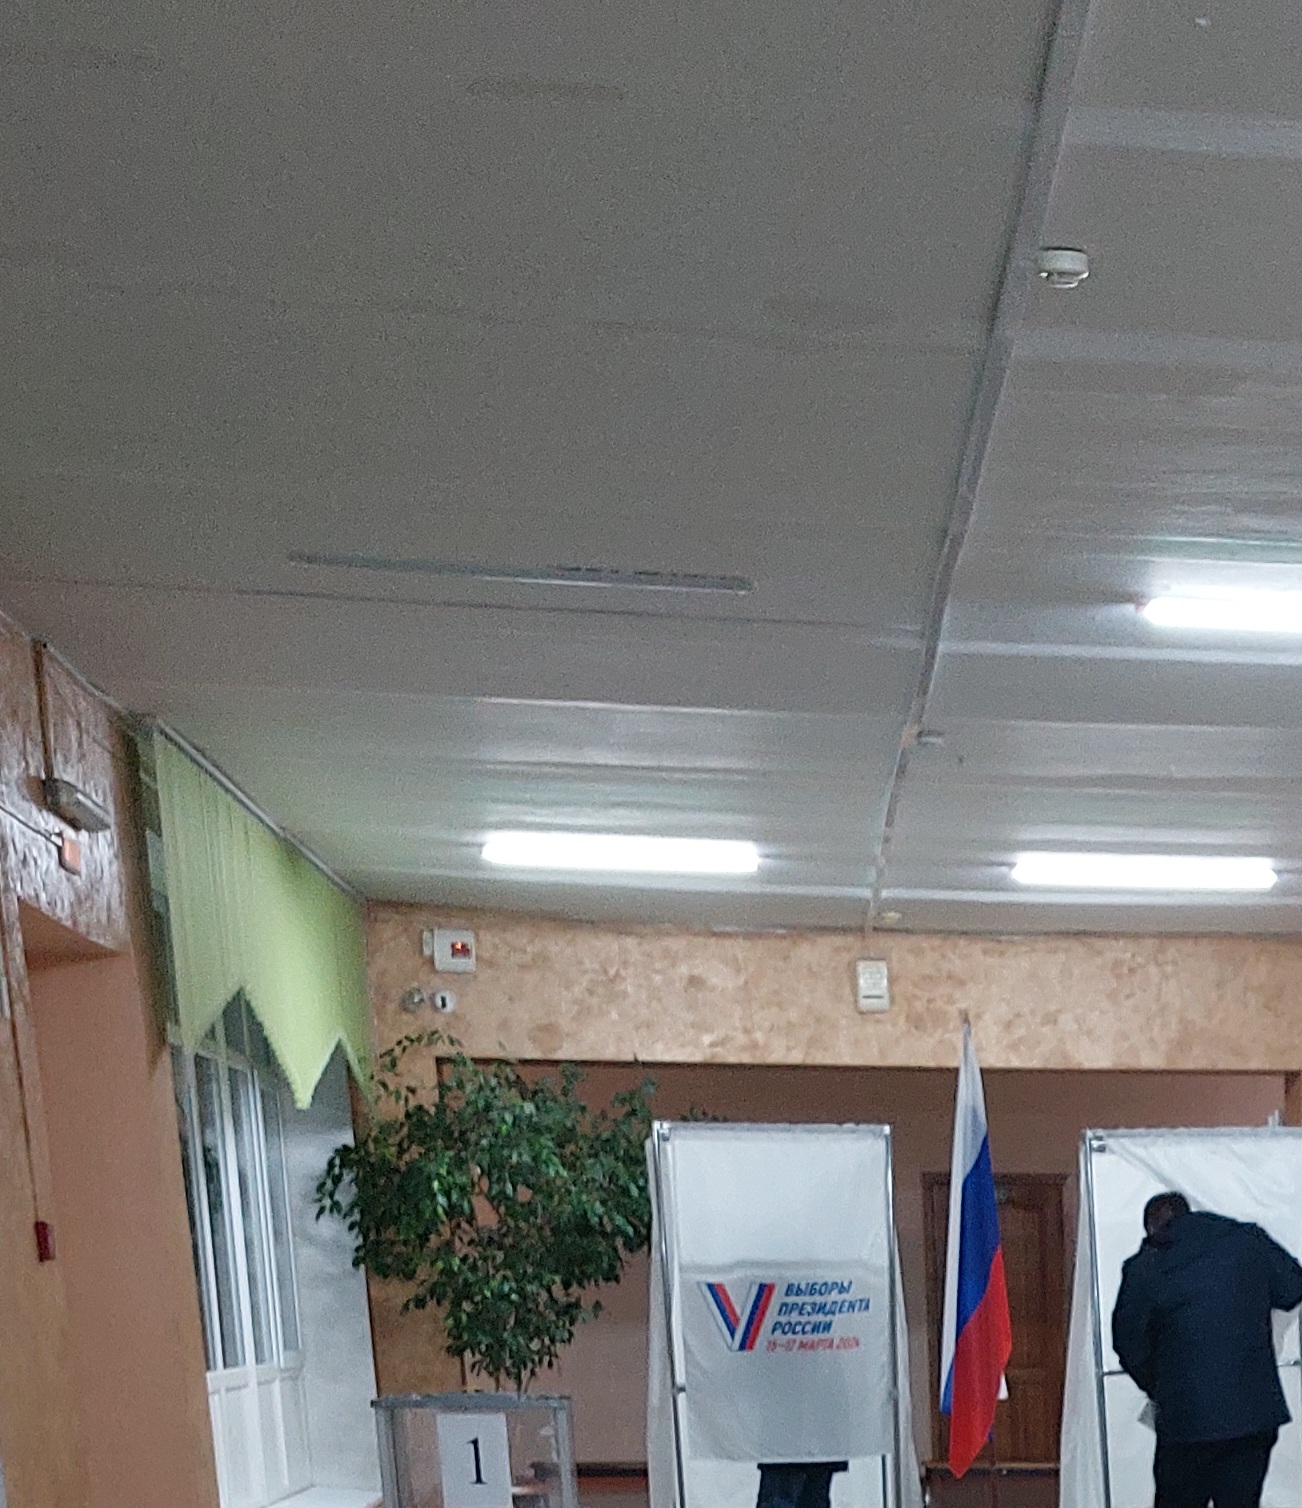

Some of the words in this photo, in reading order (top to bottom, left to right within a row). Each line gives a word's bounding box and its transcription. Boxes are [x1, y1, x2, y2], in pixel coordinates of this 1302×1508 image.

[784, 1280, 853, 1298] ВЫБОРЫ
[777, 1298, 872, 1318] ПРЕЗИДЕНТА
[770, 1319, 834, 1336] РОССИИ
[466, 1433, 488, 1485] 1
